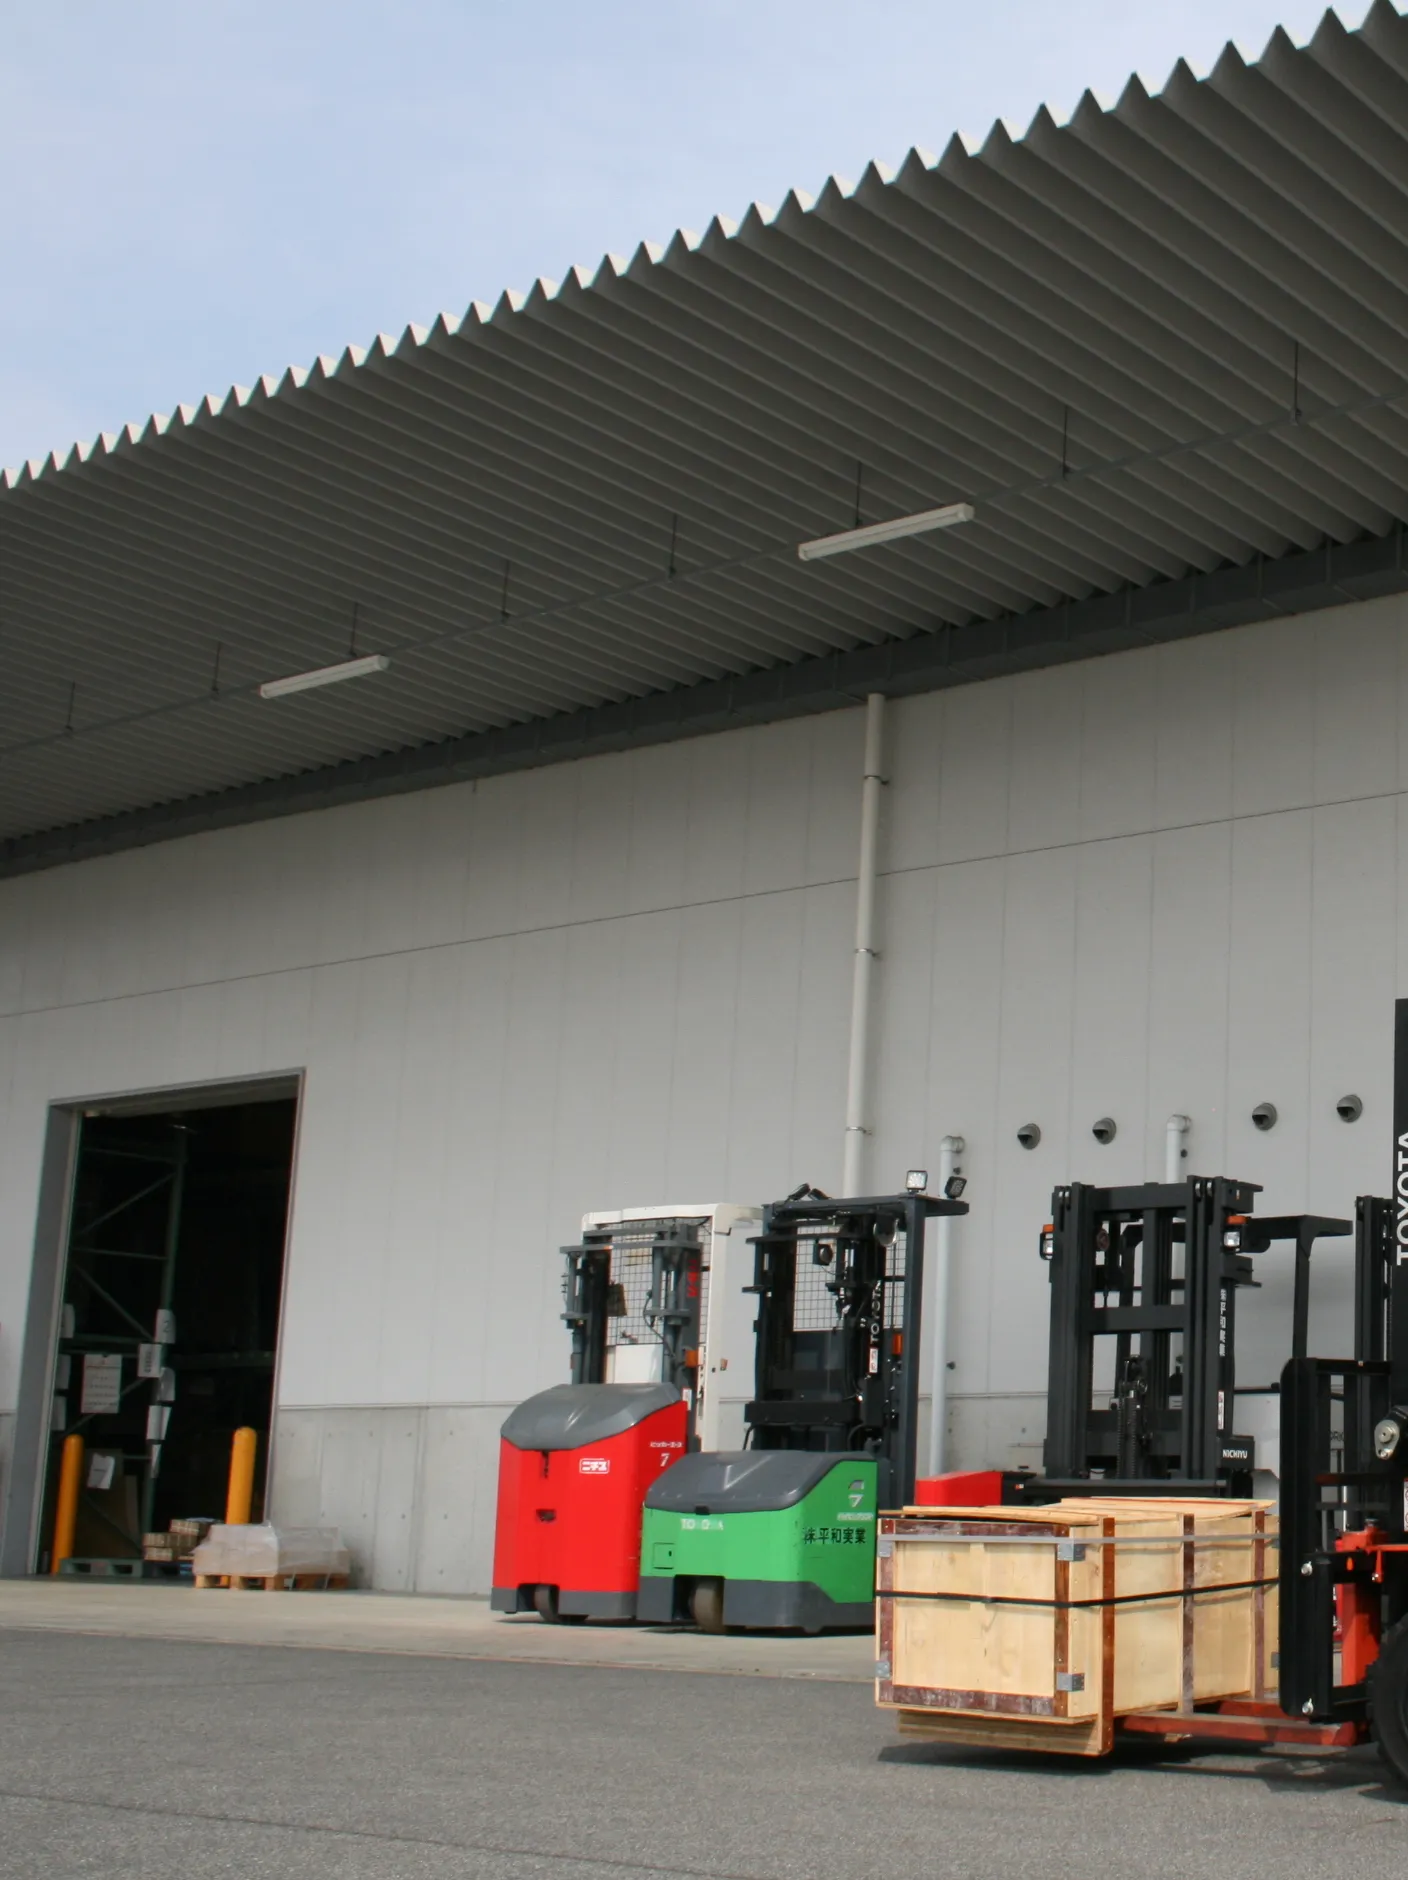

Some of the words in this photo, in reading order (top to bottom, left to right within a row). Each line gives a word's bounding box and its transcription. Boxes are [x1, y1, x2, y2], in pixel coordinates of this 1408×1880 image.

[660, 1452, 670, 1467] 7
[1222, 1449, 1248, 1459] NICHIYU
[848, 1493, 864, 1508] 7
[681, 1518, 724, 1531] TOOA
